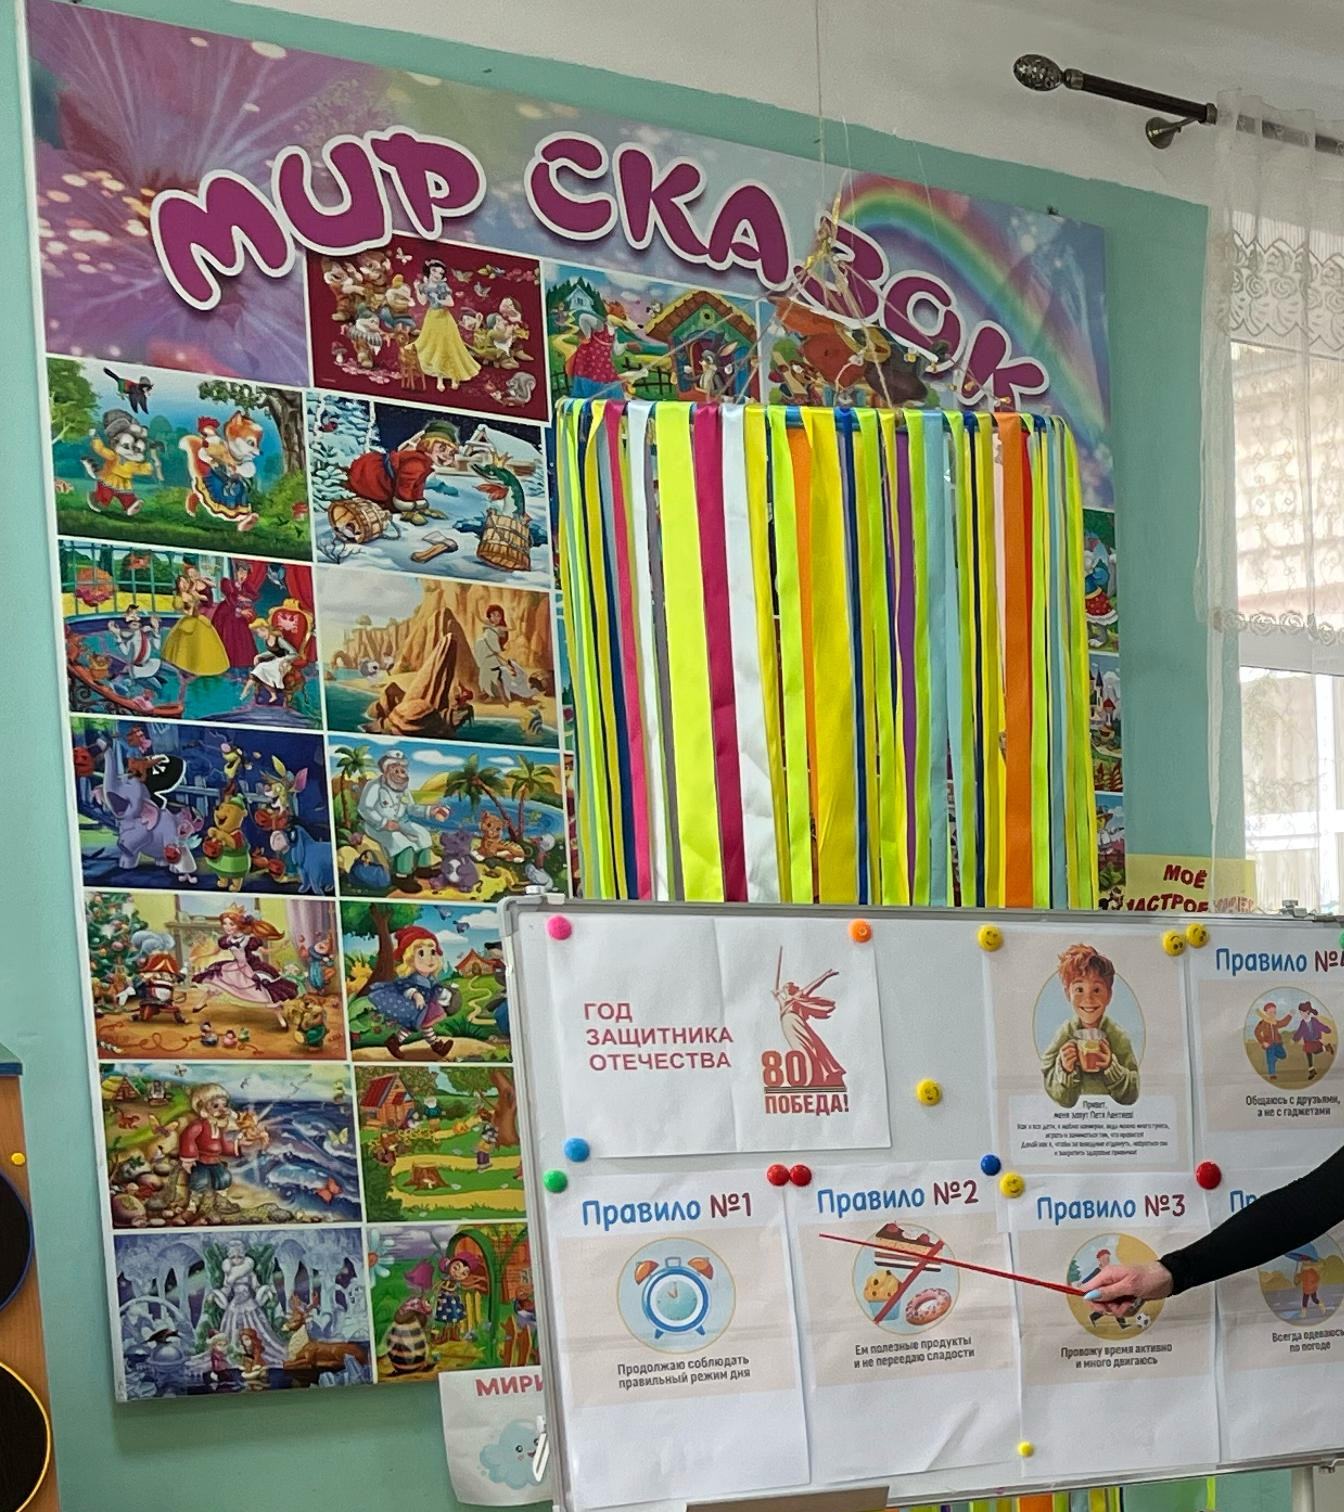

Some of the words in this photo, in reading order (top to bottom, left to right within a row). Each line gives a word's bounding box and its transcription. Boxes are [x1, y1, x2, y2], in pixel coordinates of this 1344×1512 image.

[150, 126, 486, 310] МИР
[526, 131, 1048, 412] СКАЗОК
[1163, 864, 1208, 891] МОЁ
[1216, 948, 1307, 976] Правило
[584, 1002, 633, 1023] ГОД
[585, 1026, 733, 1048] ЗАЩИТНИКА
[589, 1051, 732, 1072] ОТЕЧЕСТВА
[764, 1094, 850, 1117] ПОБЕДА!
[1245, 1095, 1288, 1107] Общаюсь
[1297, 1095, 1341, 1107] друзьями,
[1264, 1108, 1275, 1117] не
[1283, 1107, 1331, 1117] гаджетами
[817, 1187, 925, 1218] Правило
[933, 1179, 979, 1207] №2
[1037, 1196, 1136, 1225] Правило
[1144, 1193, 1187, 1218] №3
[582, 1197, 701, 1232] Правило
[710, 1192, 754, 1219] №1
[855, 1344, 869, 1356] Ем
[870, 1342, 919, 1355] полезные
[920, 1335, 972, 1350] продукты
[1272, 1332, 1302, 1342] Всегда
[1303, 1328, 1344, 1340] одеваюсь
[1060, 1348, 1104, 1361] Провожу
[1105, 1346, 1133, 1358] время
[1134, 1343, 1172, 1355] активно
[1289, 1343, 1300, 1352] по
[1301, 1341, 1331, 1351] погоде
[617, 1361, 686, 1376] Продолжаю
[688, 1354, 750, 1370] соблюдать
[862, 1359, 874, 1368] не
[875, 1354, 925, 1370] переедаю
[926, 1349, 975, 1363] сладости
[1083, 1359, 1112, 1369] много
[1113, 1356, 1158, 1367] двигаюсь
[618, 1371, 688, 1389] правильный
[689, 1370, 729, 1385] режим
[730, 1367, 751, 1382] дня
